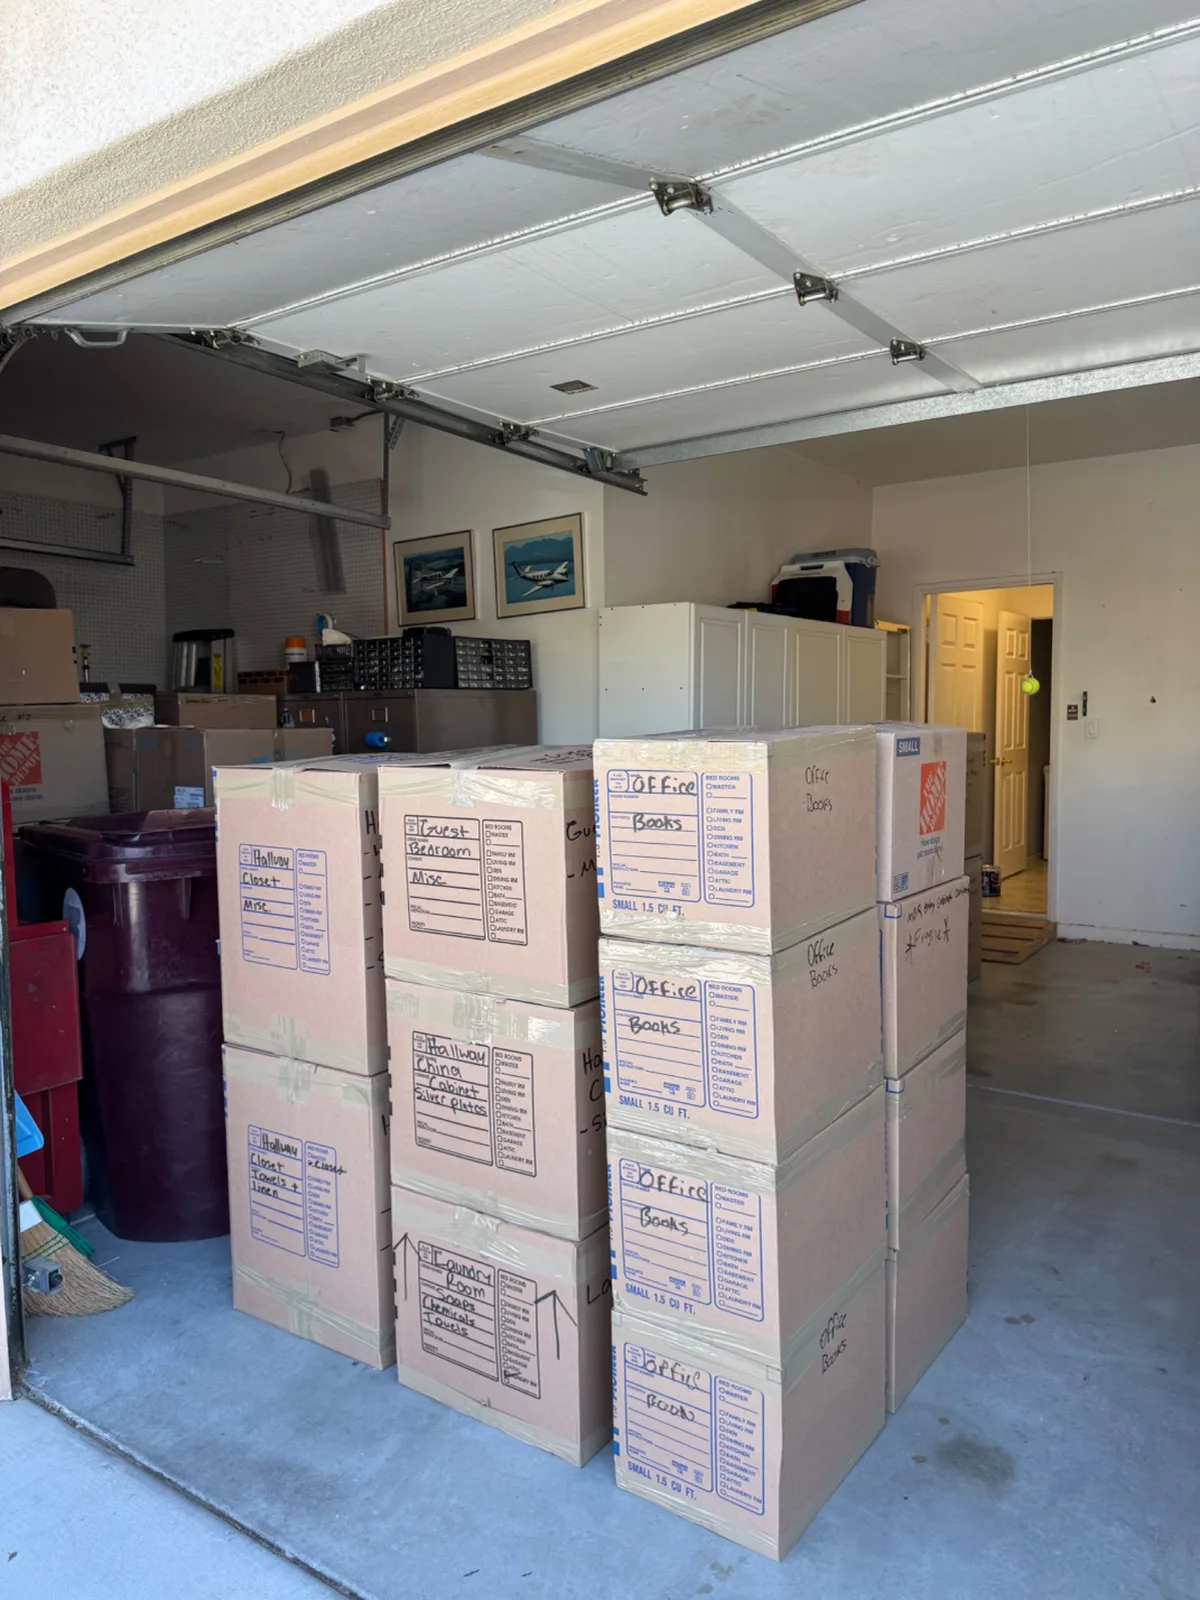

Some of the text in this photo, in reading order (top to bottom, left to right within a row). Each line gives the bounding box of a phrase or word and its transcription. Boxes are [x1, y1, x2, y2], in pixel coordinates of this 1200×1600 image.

[898, 741, 919, 753] SMALL
[632, 776, 697, 796] Office
[421, 819, 470, 837] Guest
[633, 813, 682, 832] Books
[409, 842, 471, 858] Bedroom
[242, 872, 280, 888] Closet
[412, 871, 447, 886] Misc
[613, 899, 638, 911] SMALL
[642, 903, 653, 912] 1.5
[635, 977, 697, 999] Office
[629, 1016, 680, 1036] Books
[428, 1037, 486, 1065] Hallway
[416, 1058, 462, 1079] China
[415, 1086, 446, 1104] Silver
[429, 1076, 479, 1098] Cabinet
[619, 1095, 690, 1119] SMALL 1.5 CU FT.
[262, 1133, 298, 1156] Hallway
[250, 1152, 284, 1172] Closet
[251, 1170, 286, 1187] Towels
[640, 1170, 709, 1203] Office
[640, 1206, 689, 1236] Books
[434, 1249, 492, 1286] Laundry
[446, 1270, 486, 1298] Room
[435, 1288, 476, 1312] Soaps
[625, 1282, 696, 1315] SMALL 1.5 CU FT.
[422, 1296, 476, 1327] Chemicals
[423, 1311, 469, 1336] Towels
[628, 1460, 697, 1500] SMALL 1.5 CU FT.
